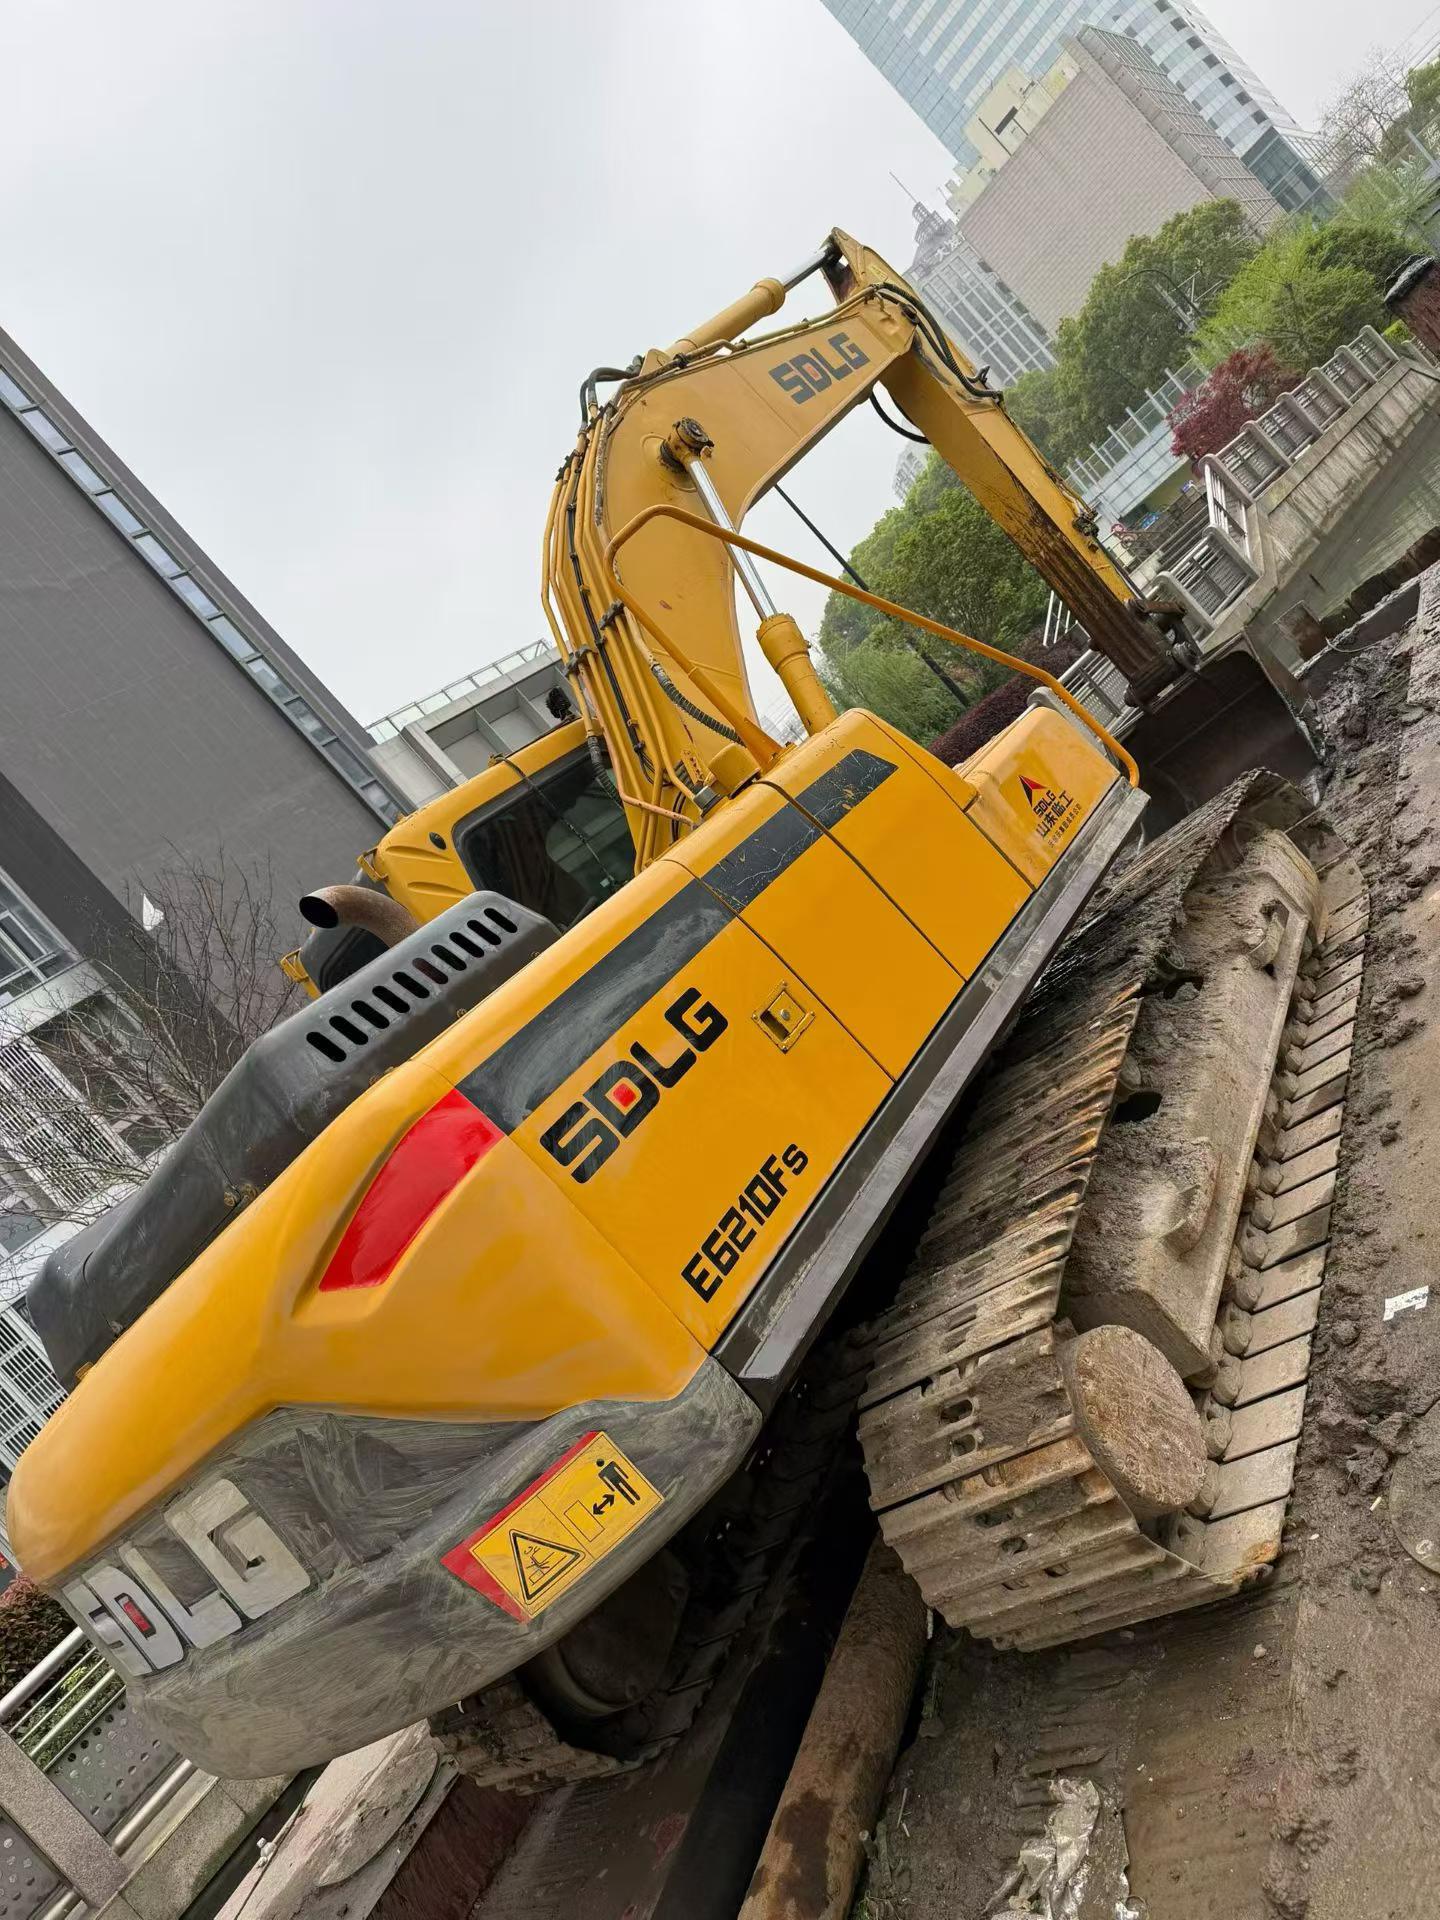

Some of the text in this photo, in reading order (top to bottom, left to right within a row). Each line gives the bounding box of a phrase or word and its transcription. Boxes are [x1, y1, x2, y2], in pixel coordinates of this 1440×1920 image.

[768, 332, 871, 405] SDLG
[1033, 790, 1057, 818] SDLG
[1036, 790, 1074, 837] 山东临工
[539, 987, 729, 1184] SDLG
